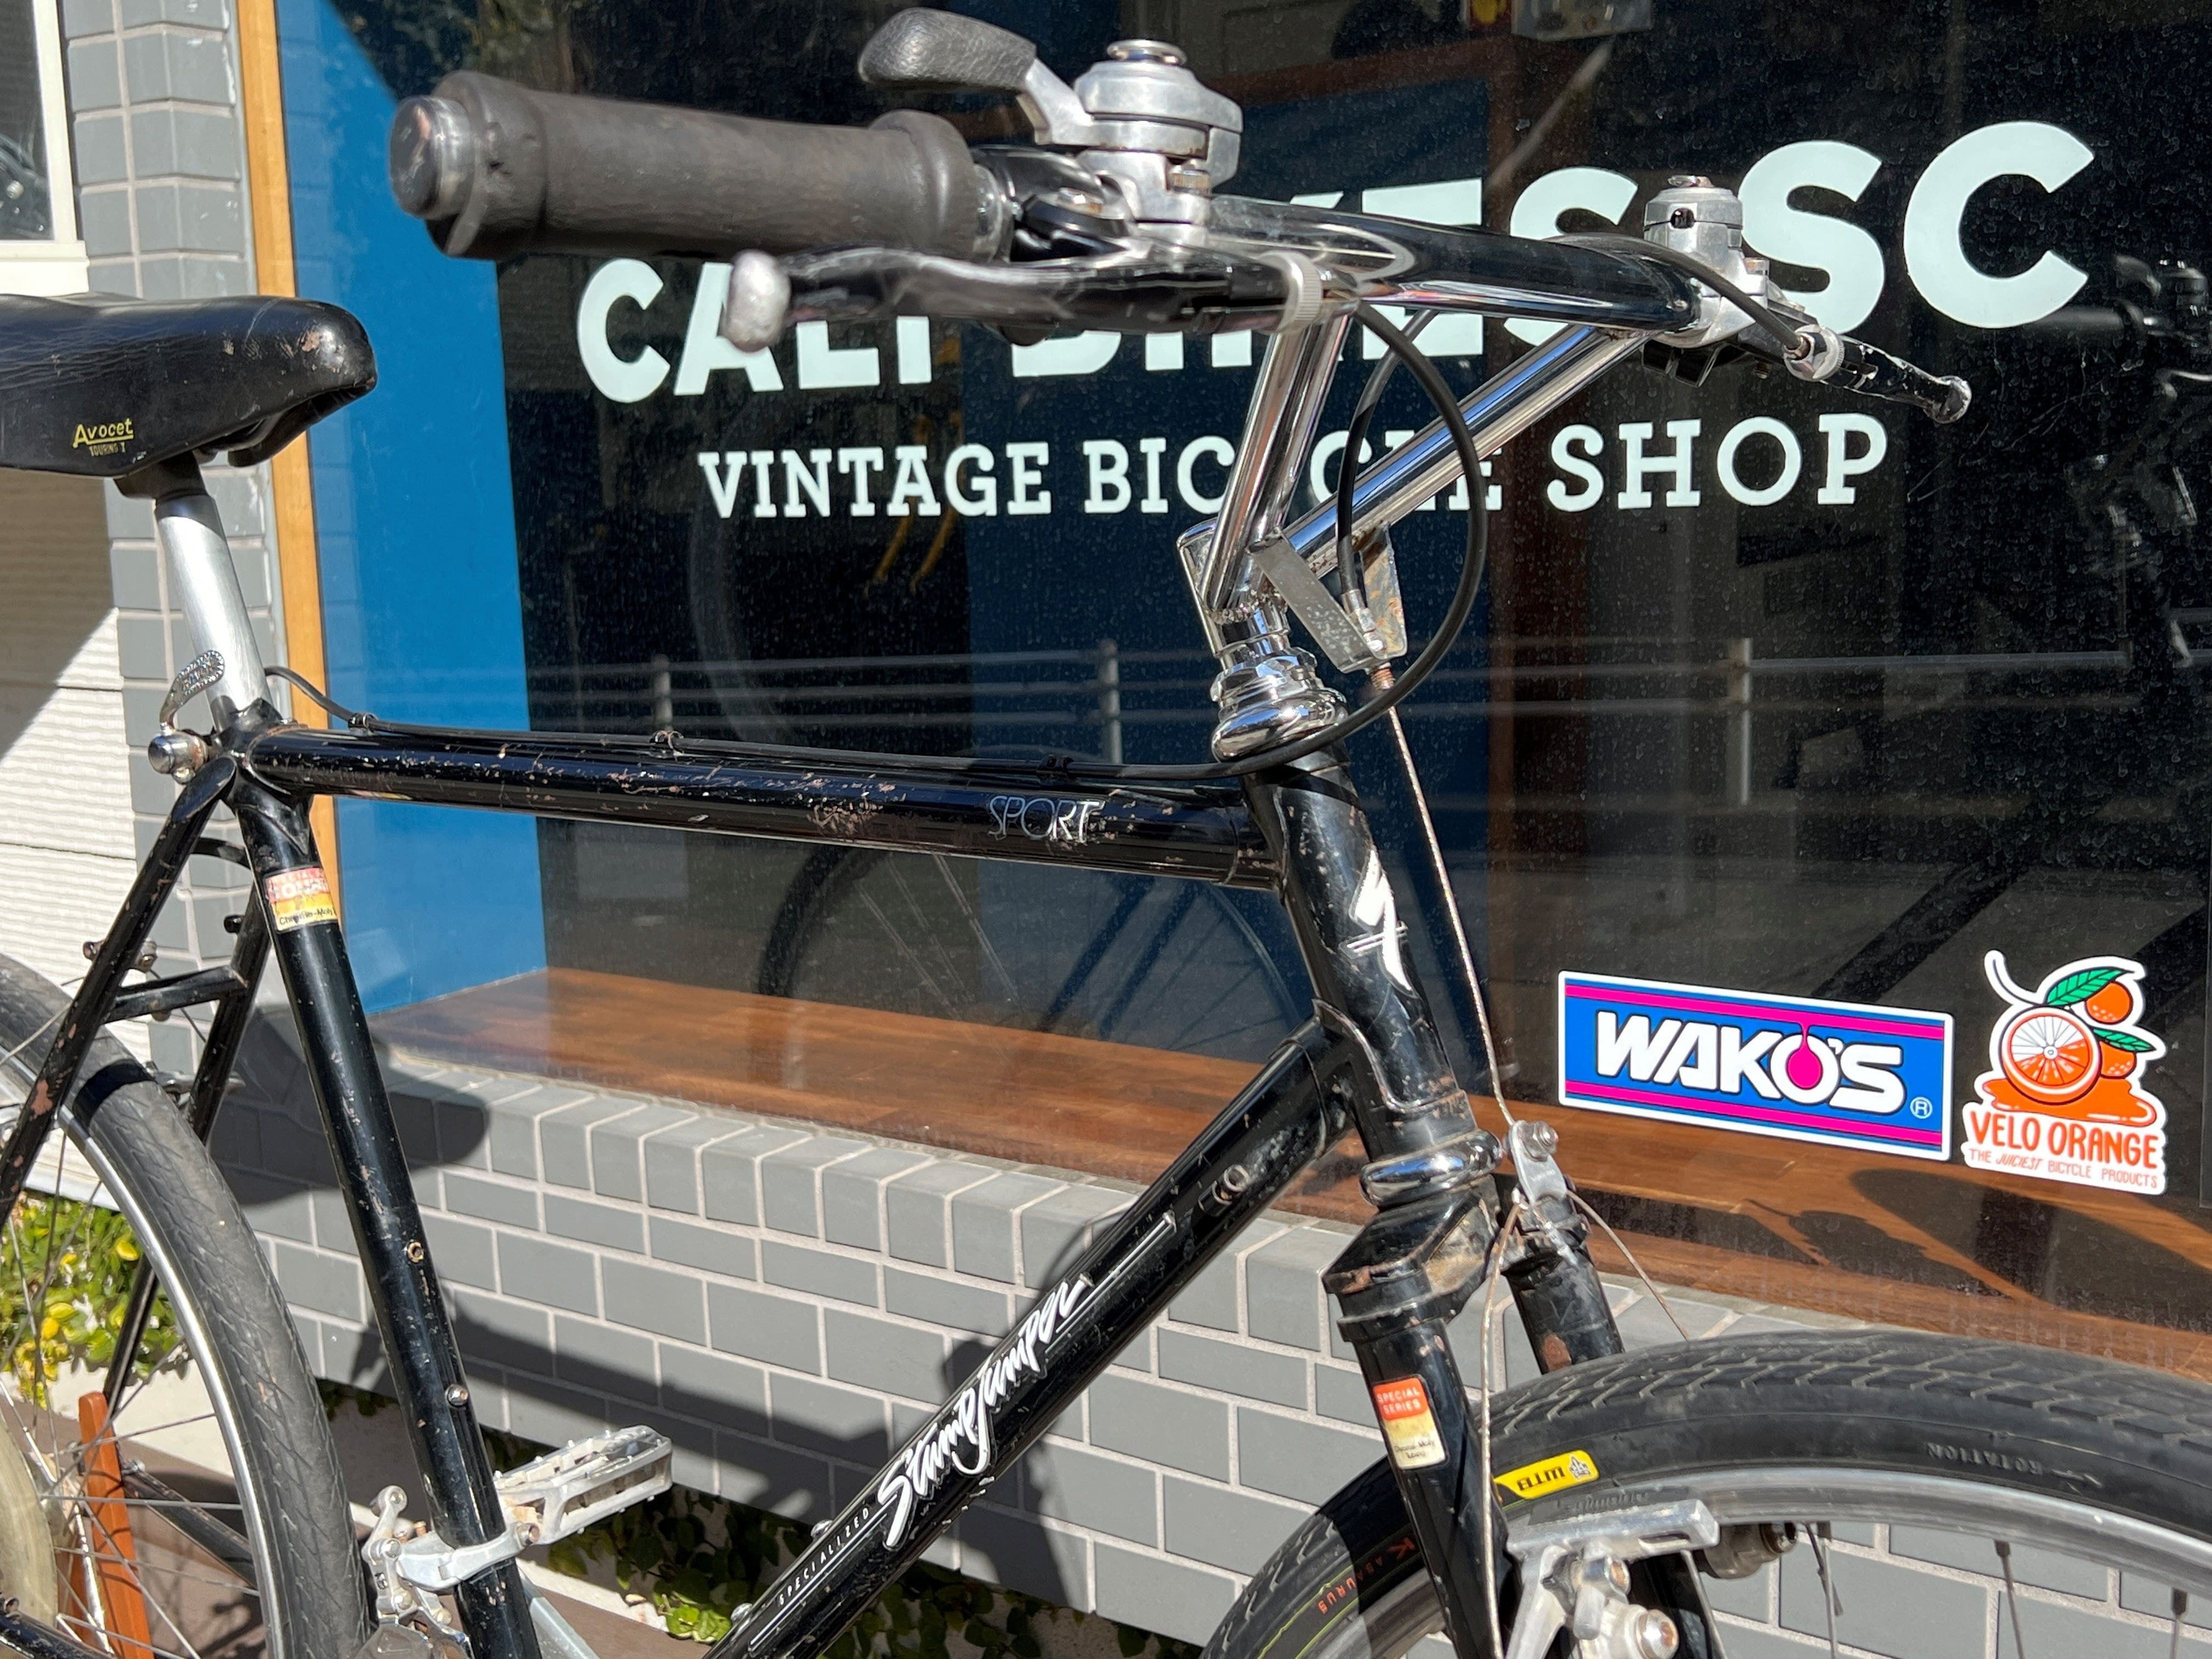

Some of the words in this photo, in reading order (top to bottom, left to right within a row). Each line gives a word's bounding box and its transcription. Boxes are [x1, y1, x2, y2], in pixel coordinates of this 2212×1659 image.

[1737, 121, 2095, 335] SC
[72, 417, 134, 449] Avocet
[697, 441, 1052, 518] VINTAGE
[1547, 413, 1887, 512] SHOP
[988, 795, 1105, 843] SPORT
[1597, 1011, 1906, 1115] WAKO'S
[1970, 1110, 2040, 1151] VELO
[2048, 1121, 2159, 1169] ORANGE
[1969, 1148, 1993, 1164] THE
[1995, 1153, 2043, 1171] JUICIEST
[2047, 1161, 2091, 1179] BICYCLE
[2101, 1168, 2158, 1189] PRODUCTS
[1376, 1387, 1421, 1403] SPECIAL
[1383, 1398, 1421, 1414] SERIES
[1926, 1442, 2042, 1476] ROTATION
[778, 1504, 871, 1607] SPECIALIZED
